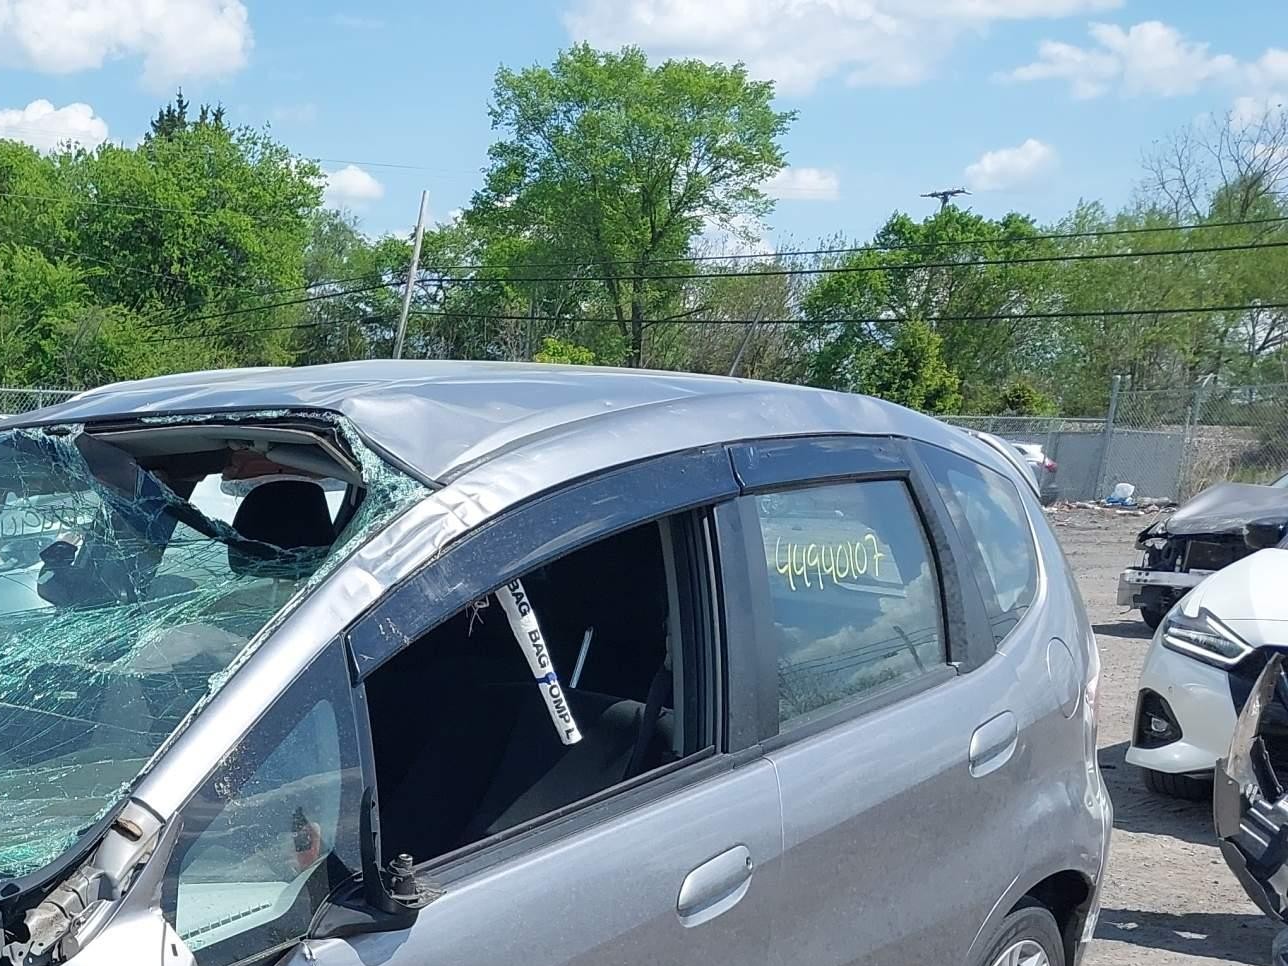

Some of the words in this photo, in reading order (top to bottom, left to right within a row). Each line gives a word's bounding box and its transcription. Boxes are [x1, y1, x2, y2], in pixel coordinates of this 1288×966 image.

[775, 533, 886, 591] 44940107
[527, 629, 550, 669] BAG
[546, 679, 571, 724] OMP
